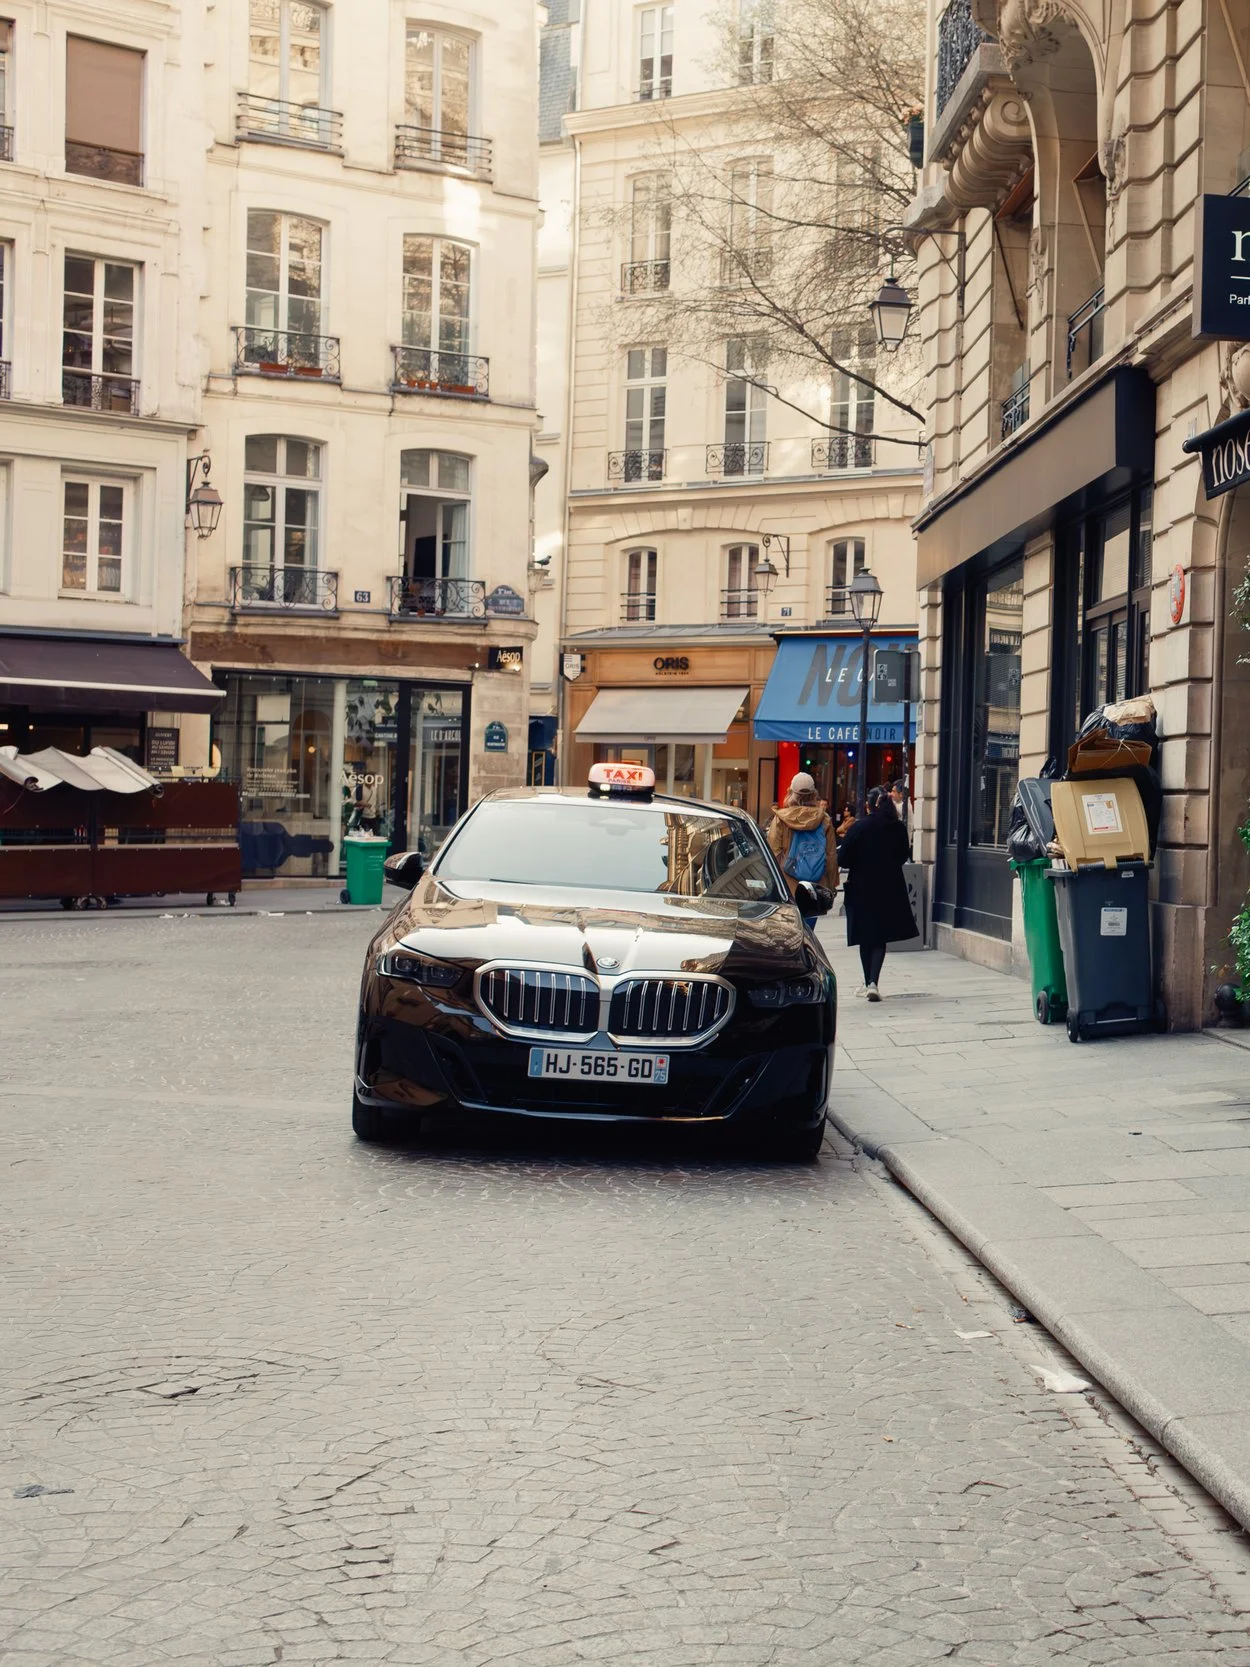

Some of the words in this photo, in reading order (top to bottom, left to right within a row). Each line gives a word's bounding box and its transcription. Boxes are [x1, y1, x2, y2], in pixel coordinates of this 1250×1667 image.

[356, 592, 369, 602] 63
[653, 656, 689, 670] ORIS
[808, 727, 821, 740] LE
[828, 725, 859, 741] CAFÉ
[866, 728, 896, 740] NOIR
[603, 768, 643, 781] TAXI
[654, 1071, 666, 1081] 75
